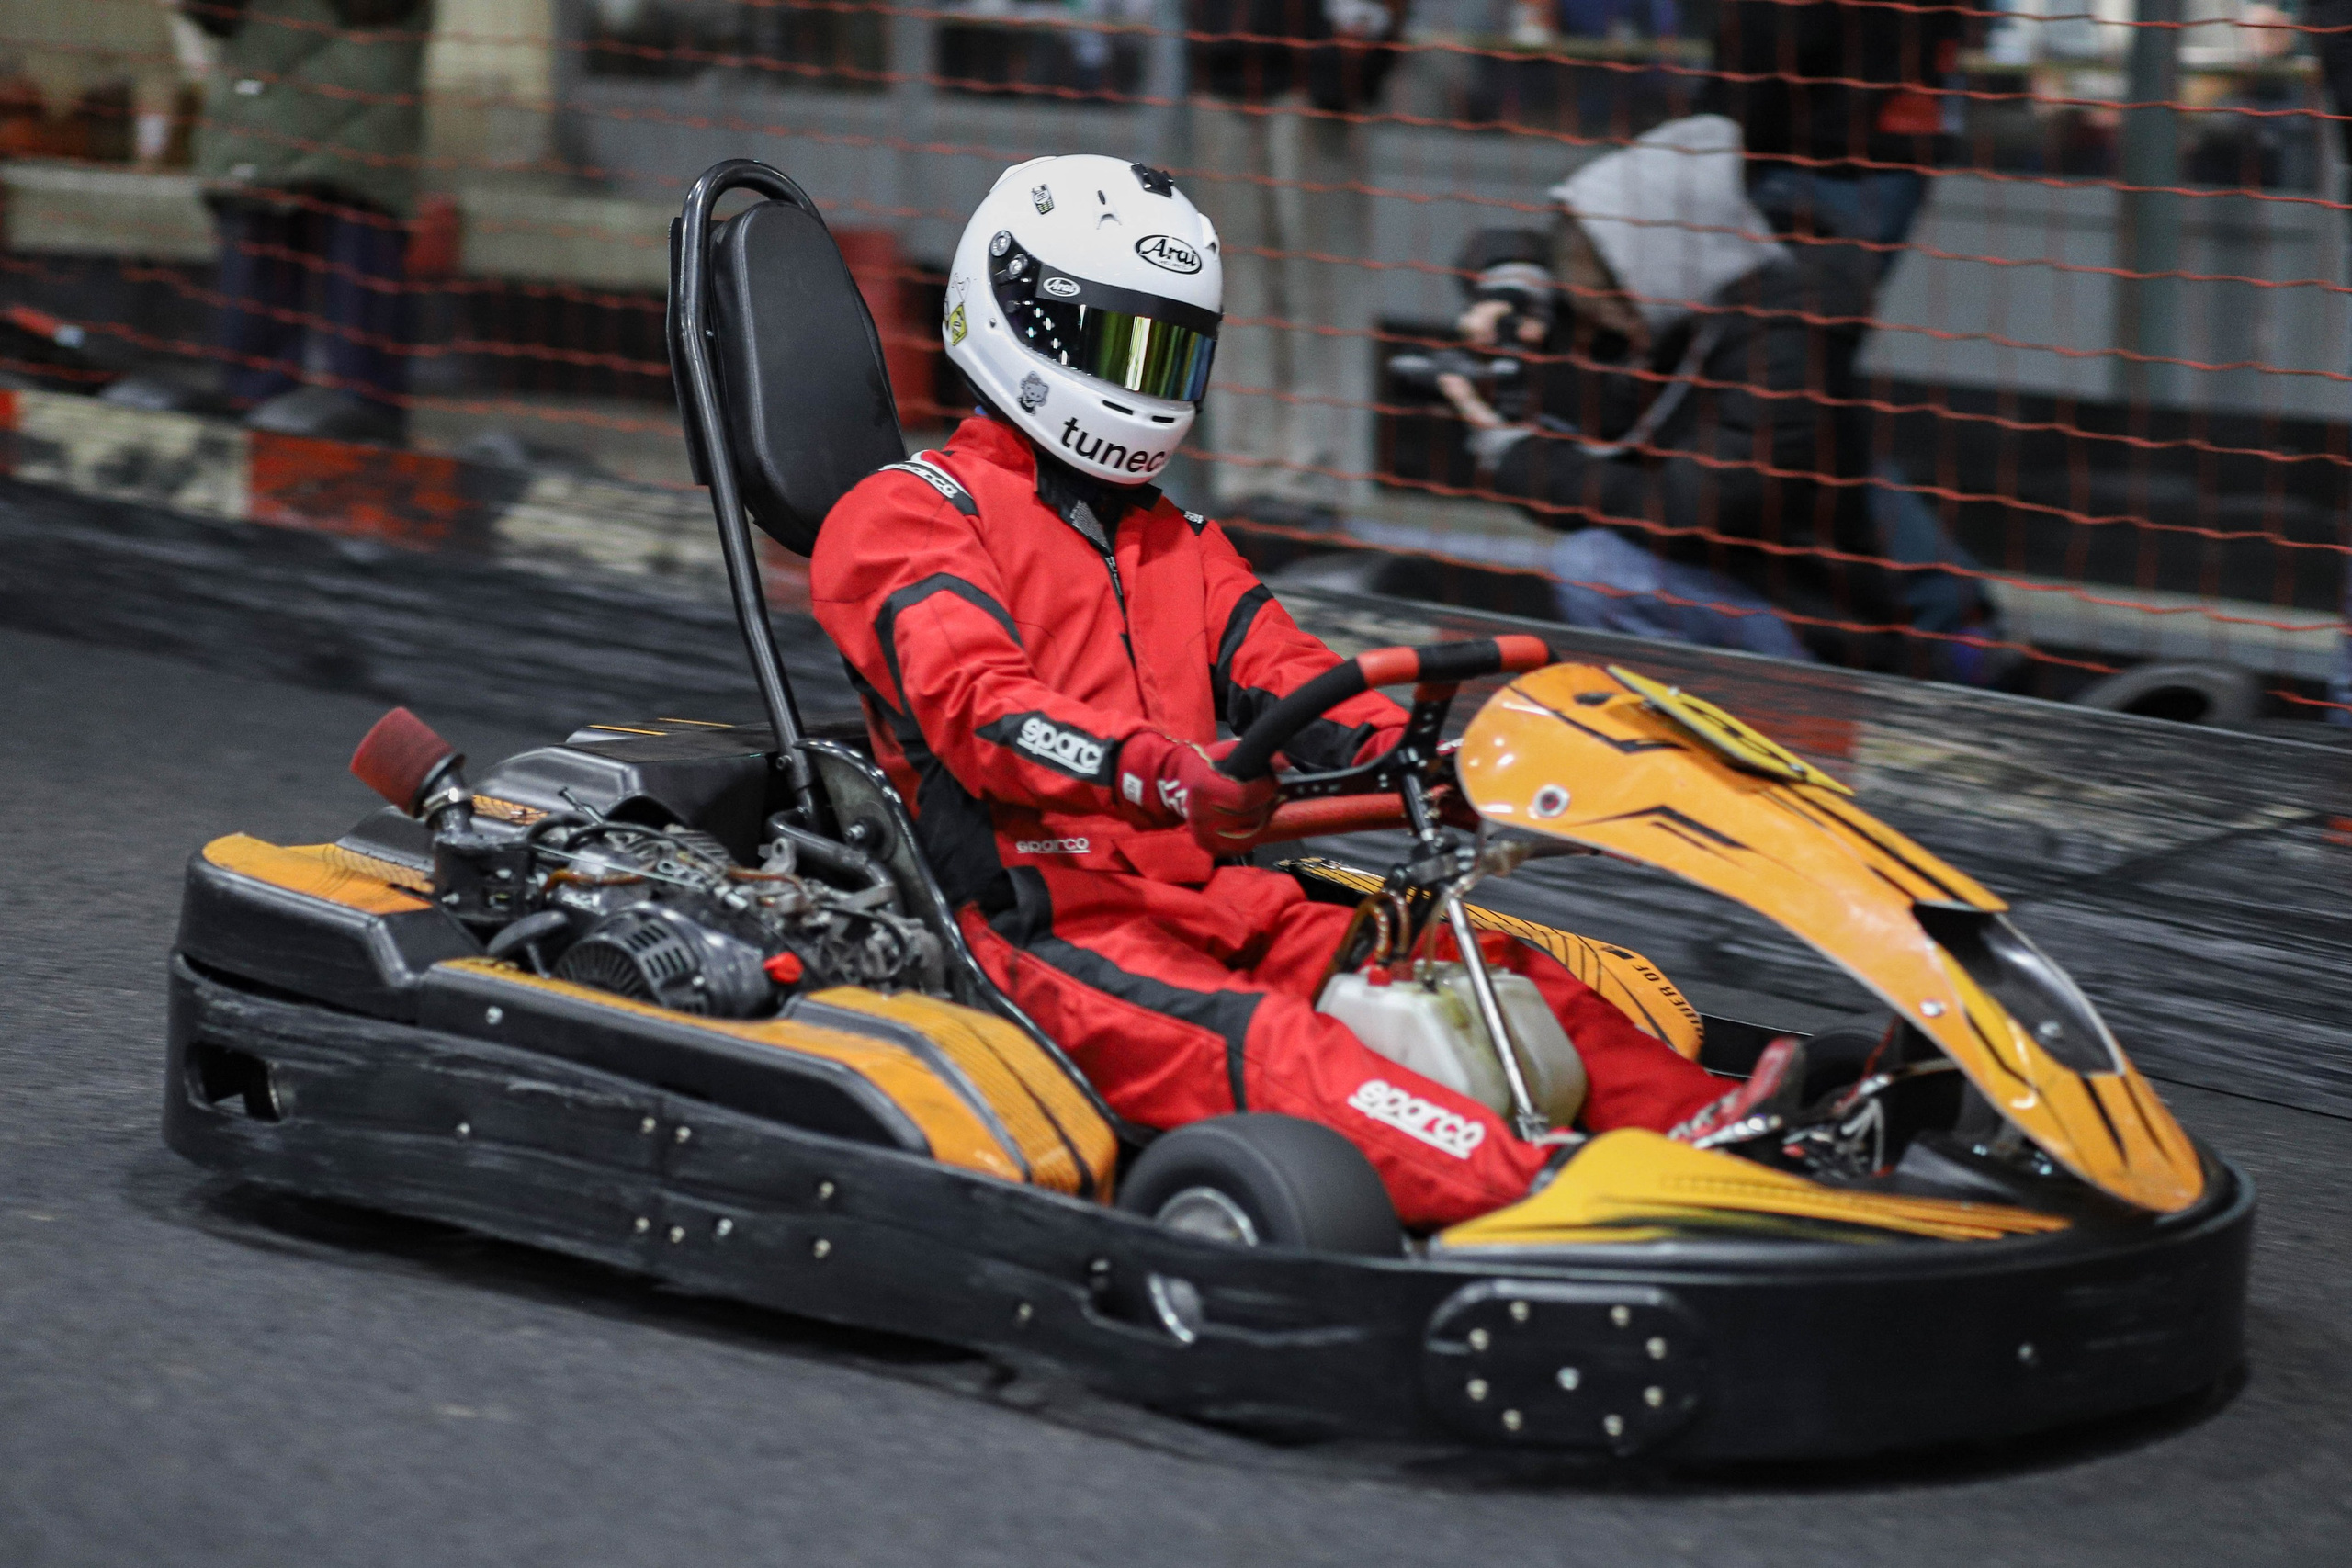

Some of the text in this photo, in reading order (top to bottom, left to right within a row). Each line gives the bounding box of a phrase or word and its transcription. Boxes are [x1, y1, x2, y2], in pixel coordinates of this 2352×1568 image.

[1141, 238, 1197, 267] Arai
[1047, 278, 1076, 293] Arai
[1017, 716, 1104, 774] sparc
[1016, 837, 1091, 854] sparco
[1348, 1079, 1486, 1160] sparco
